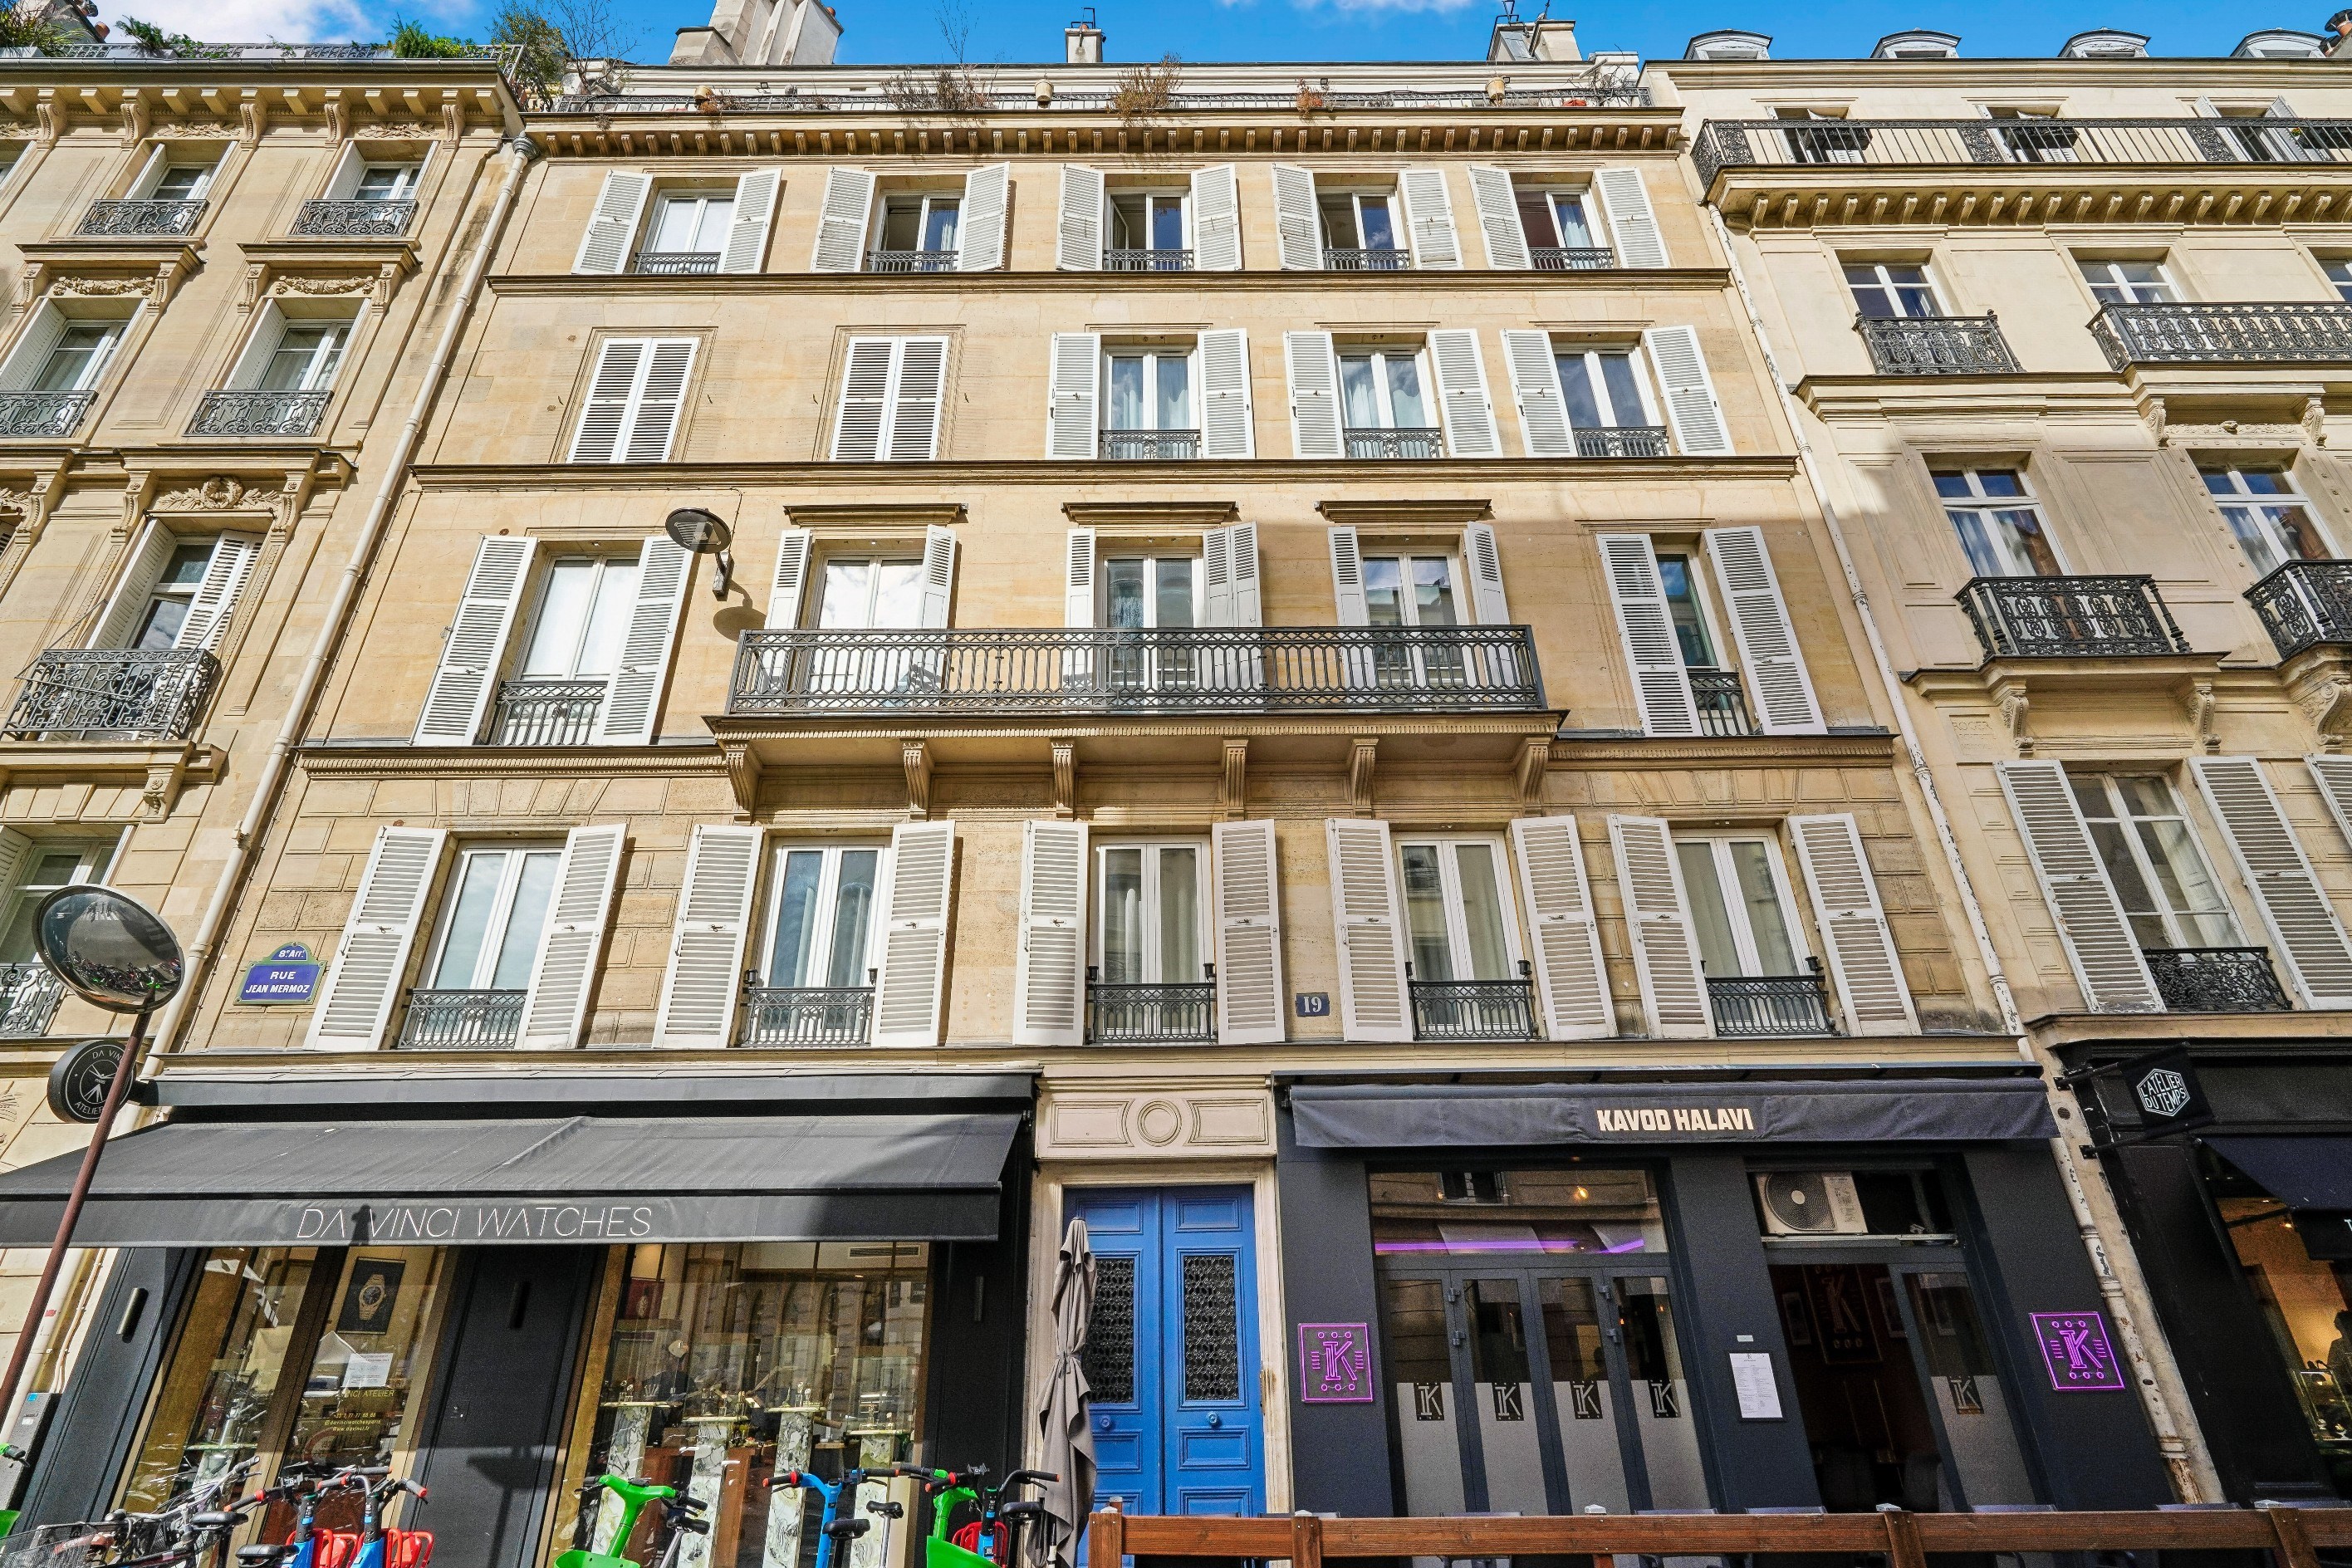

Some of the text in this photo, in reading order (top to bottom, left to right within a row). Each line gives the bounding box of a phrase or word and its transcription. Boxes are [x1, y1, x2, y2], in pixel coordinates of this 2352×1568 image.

[270, 971, 296, 980] RUE
[245, 984, 311, 993] JEAN MERMOZ
[1304, 996, 1322, 1013] 19
[92, 1050, 105, 1060] DA
[2140, 1072, 2183, 1098] L'ATELIER
[2144, 1087, 2187, 1112] DU TEMPS
[1596, 1108, 1754, 1131] KAVOD HALAVI
[296, 1207, 652, 1238] DA VINCI WATCHES
[1323, 1340, 1357, 1381] K
[2059, 1330, 2104, 1369] K
